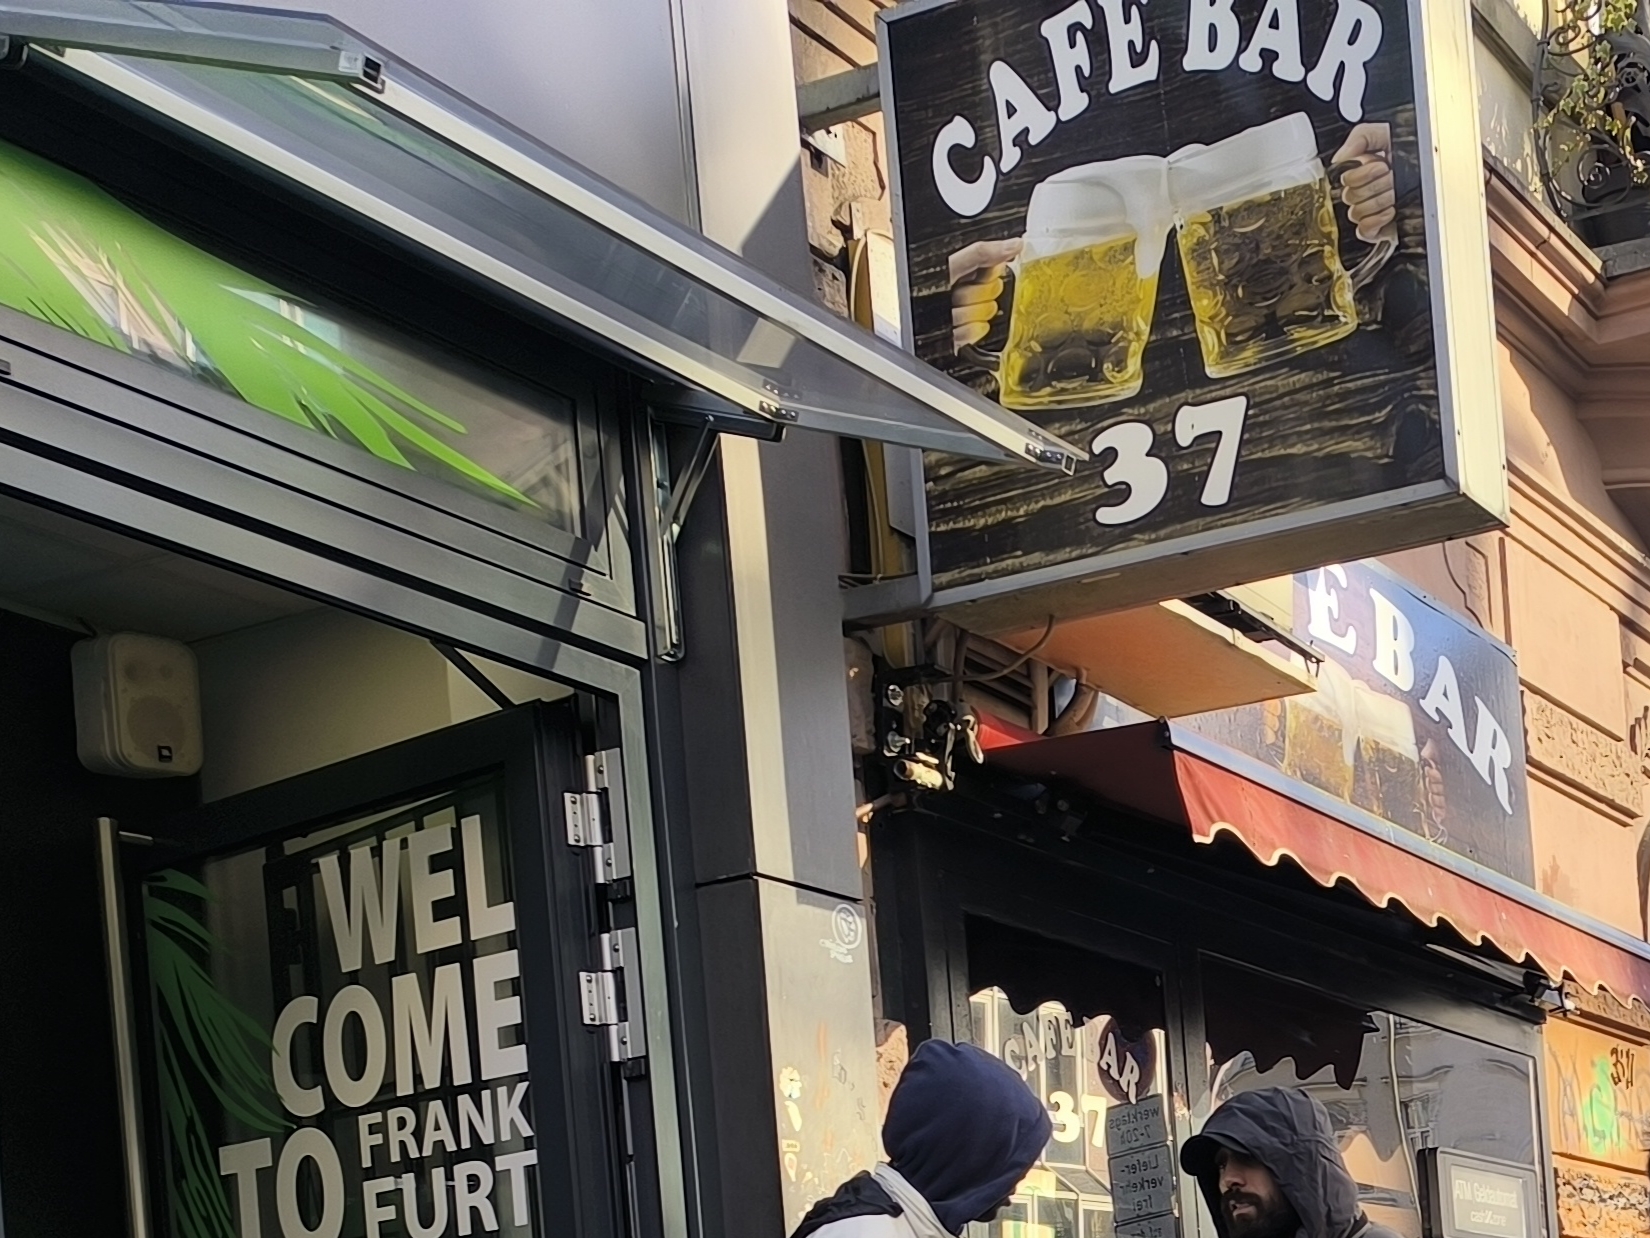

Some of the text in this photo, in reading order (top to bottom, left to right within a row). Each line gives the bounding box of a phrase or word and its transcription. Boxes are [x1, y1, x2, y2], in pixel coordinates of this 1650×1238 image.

[932, 0, 1383, 217] CAFE BAR
[1091, 396, 1248, 525] 37
[1368, 587, 1515, 815] BAR
[318, 814, 516, 973] WEL
[272, 949, 528, 1118] COME
[1004, 1011, 1077, 1081] CAFE
[358, 1081, 535, 1168] FRANK
[1050, 1090, 1108, 1148] 37
[1455, 1180, 1473, 1200] ATM
